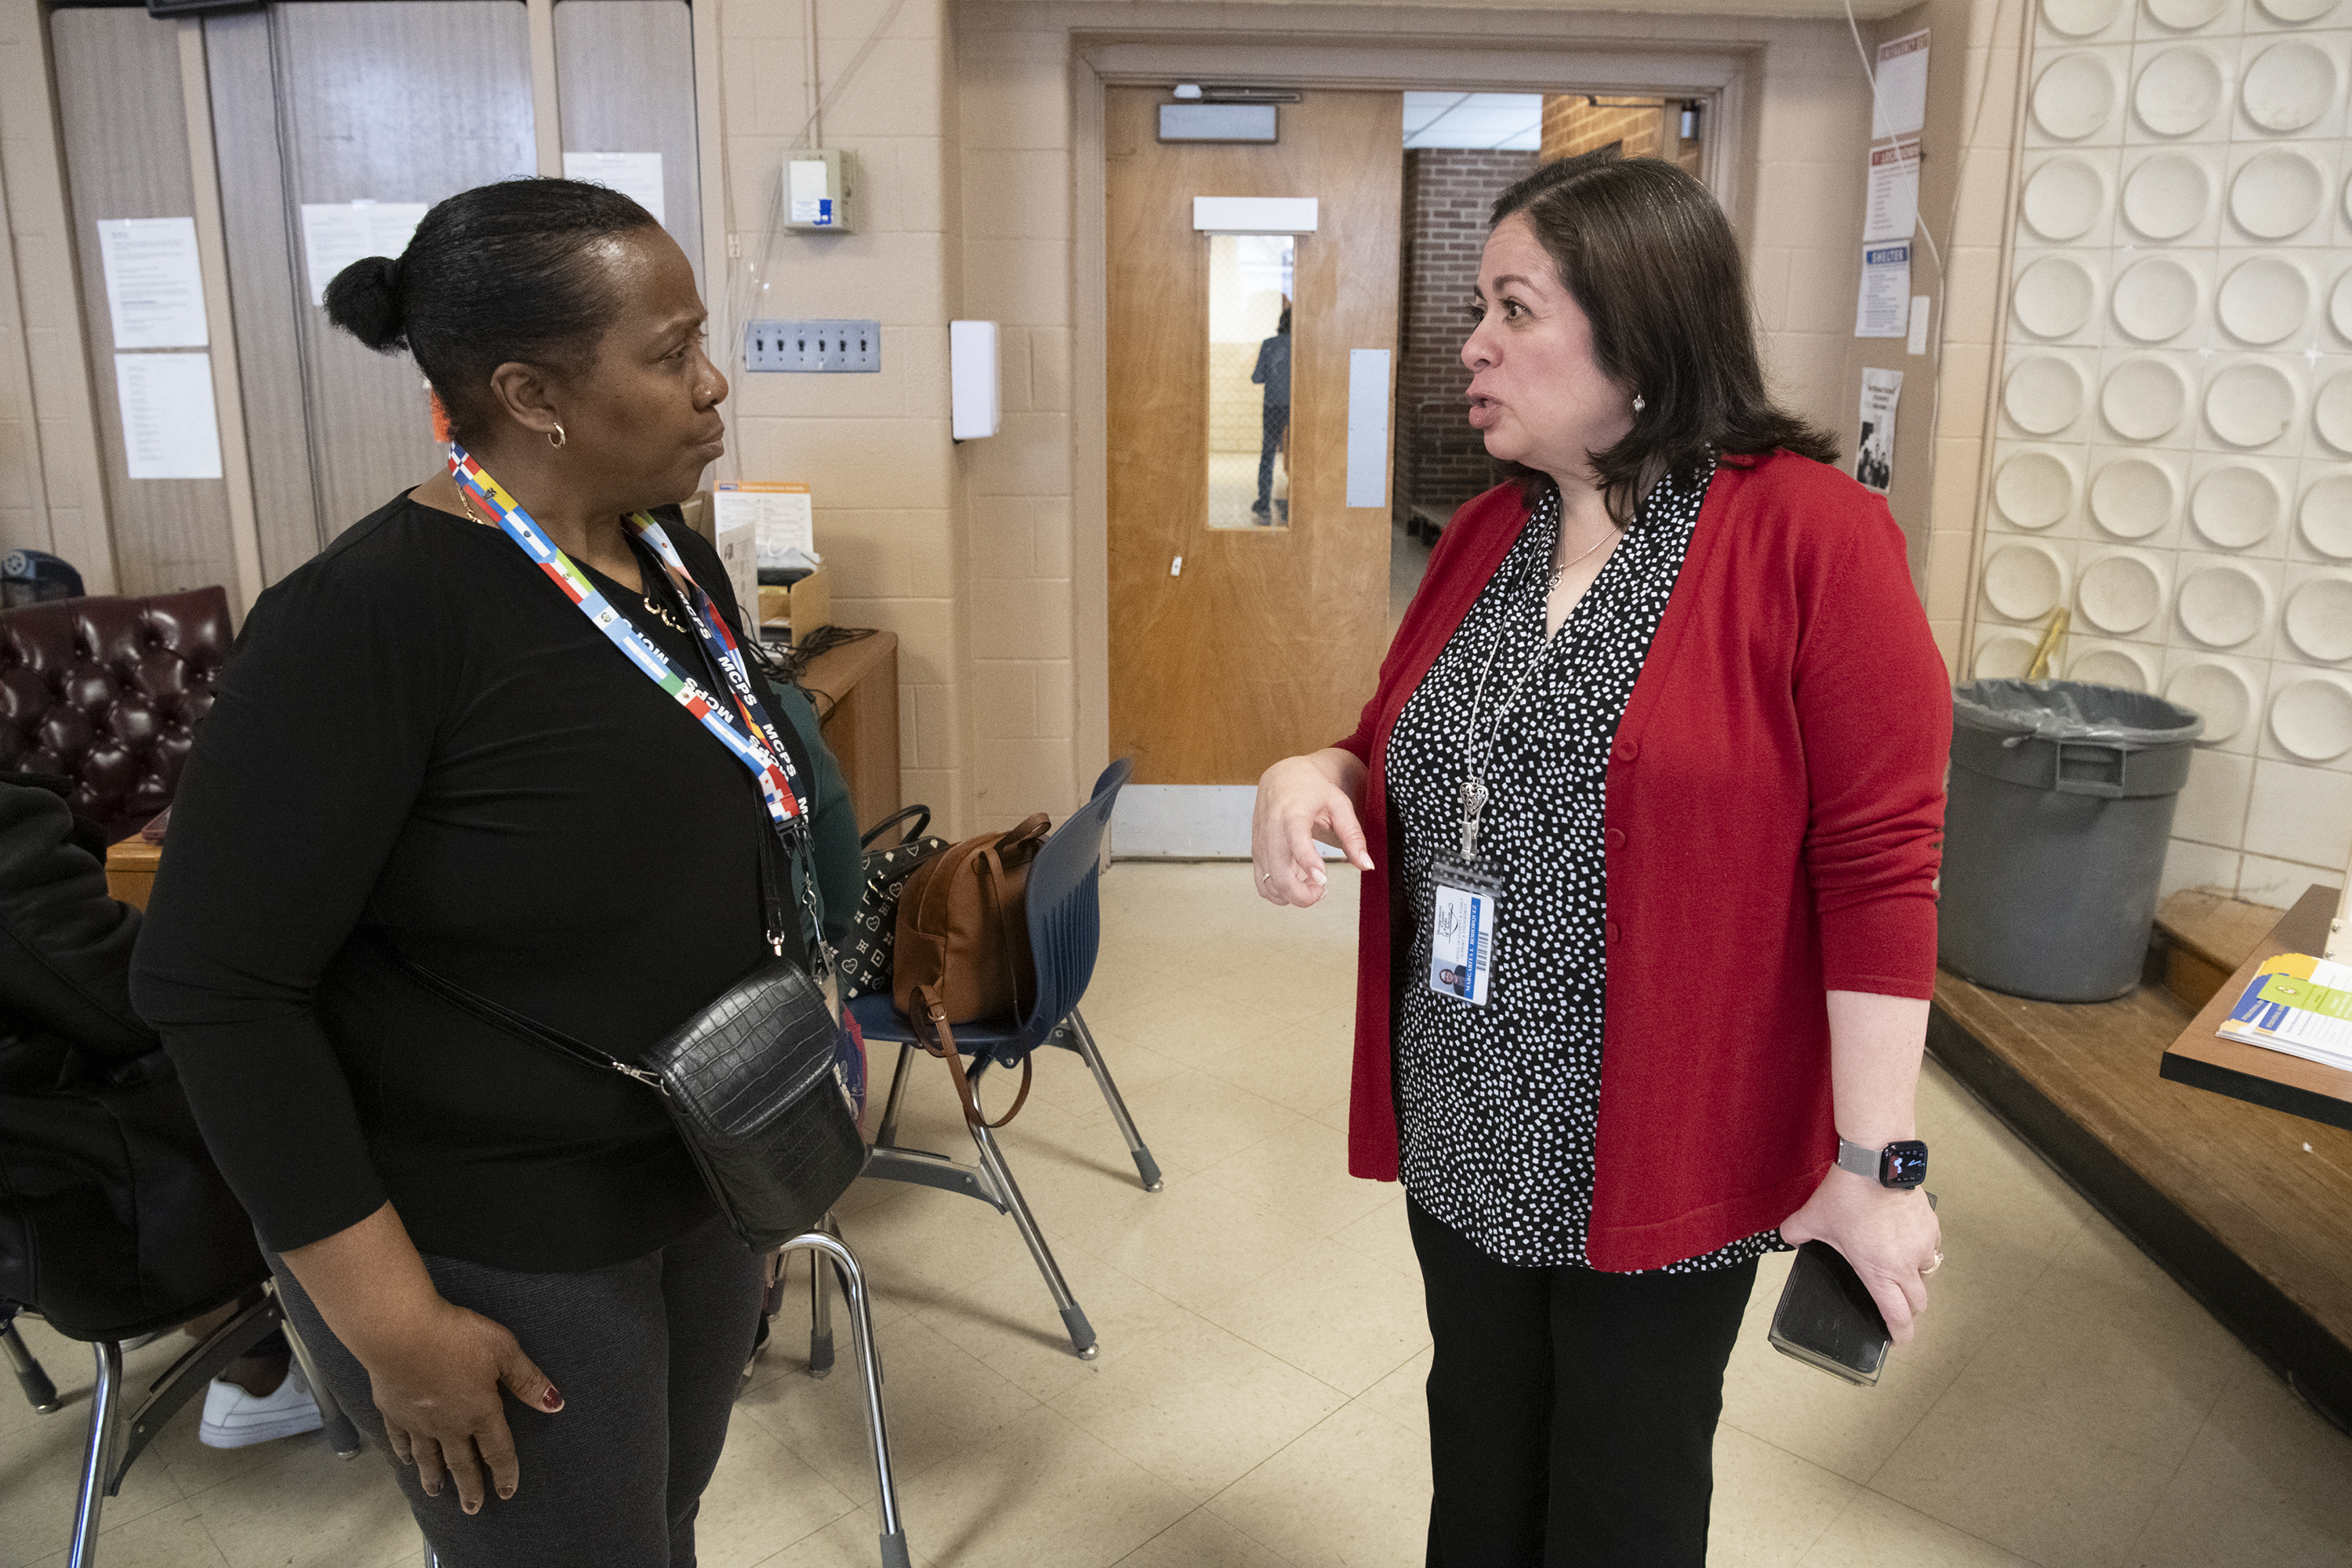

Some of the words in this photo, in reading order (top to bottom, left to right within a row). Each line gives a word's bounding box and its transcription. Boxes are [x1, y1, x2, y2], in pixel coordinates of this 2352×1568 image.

[1872, 248, 1904, 263] SHELTER
[677, 590, 712, 639] MCPS
[684, 677, 735, 724] MCPS
[718, 655, 757, 706] MCPS
[763, 723, 797, 777] MCPS
[1465, 953, 1474, 992] MARGARITA
